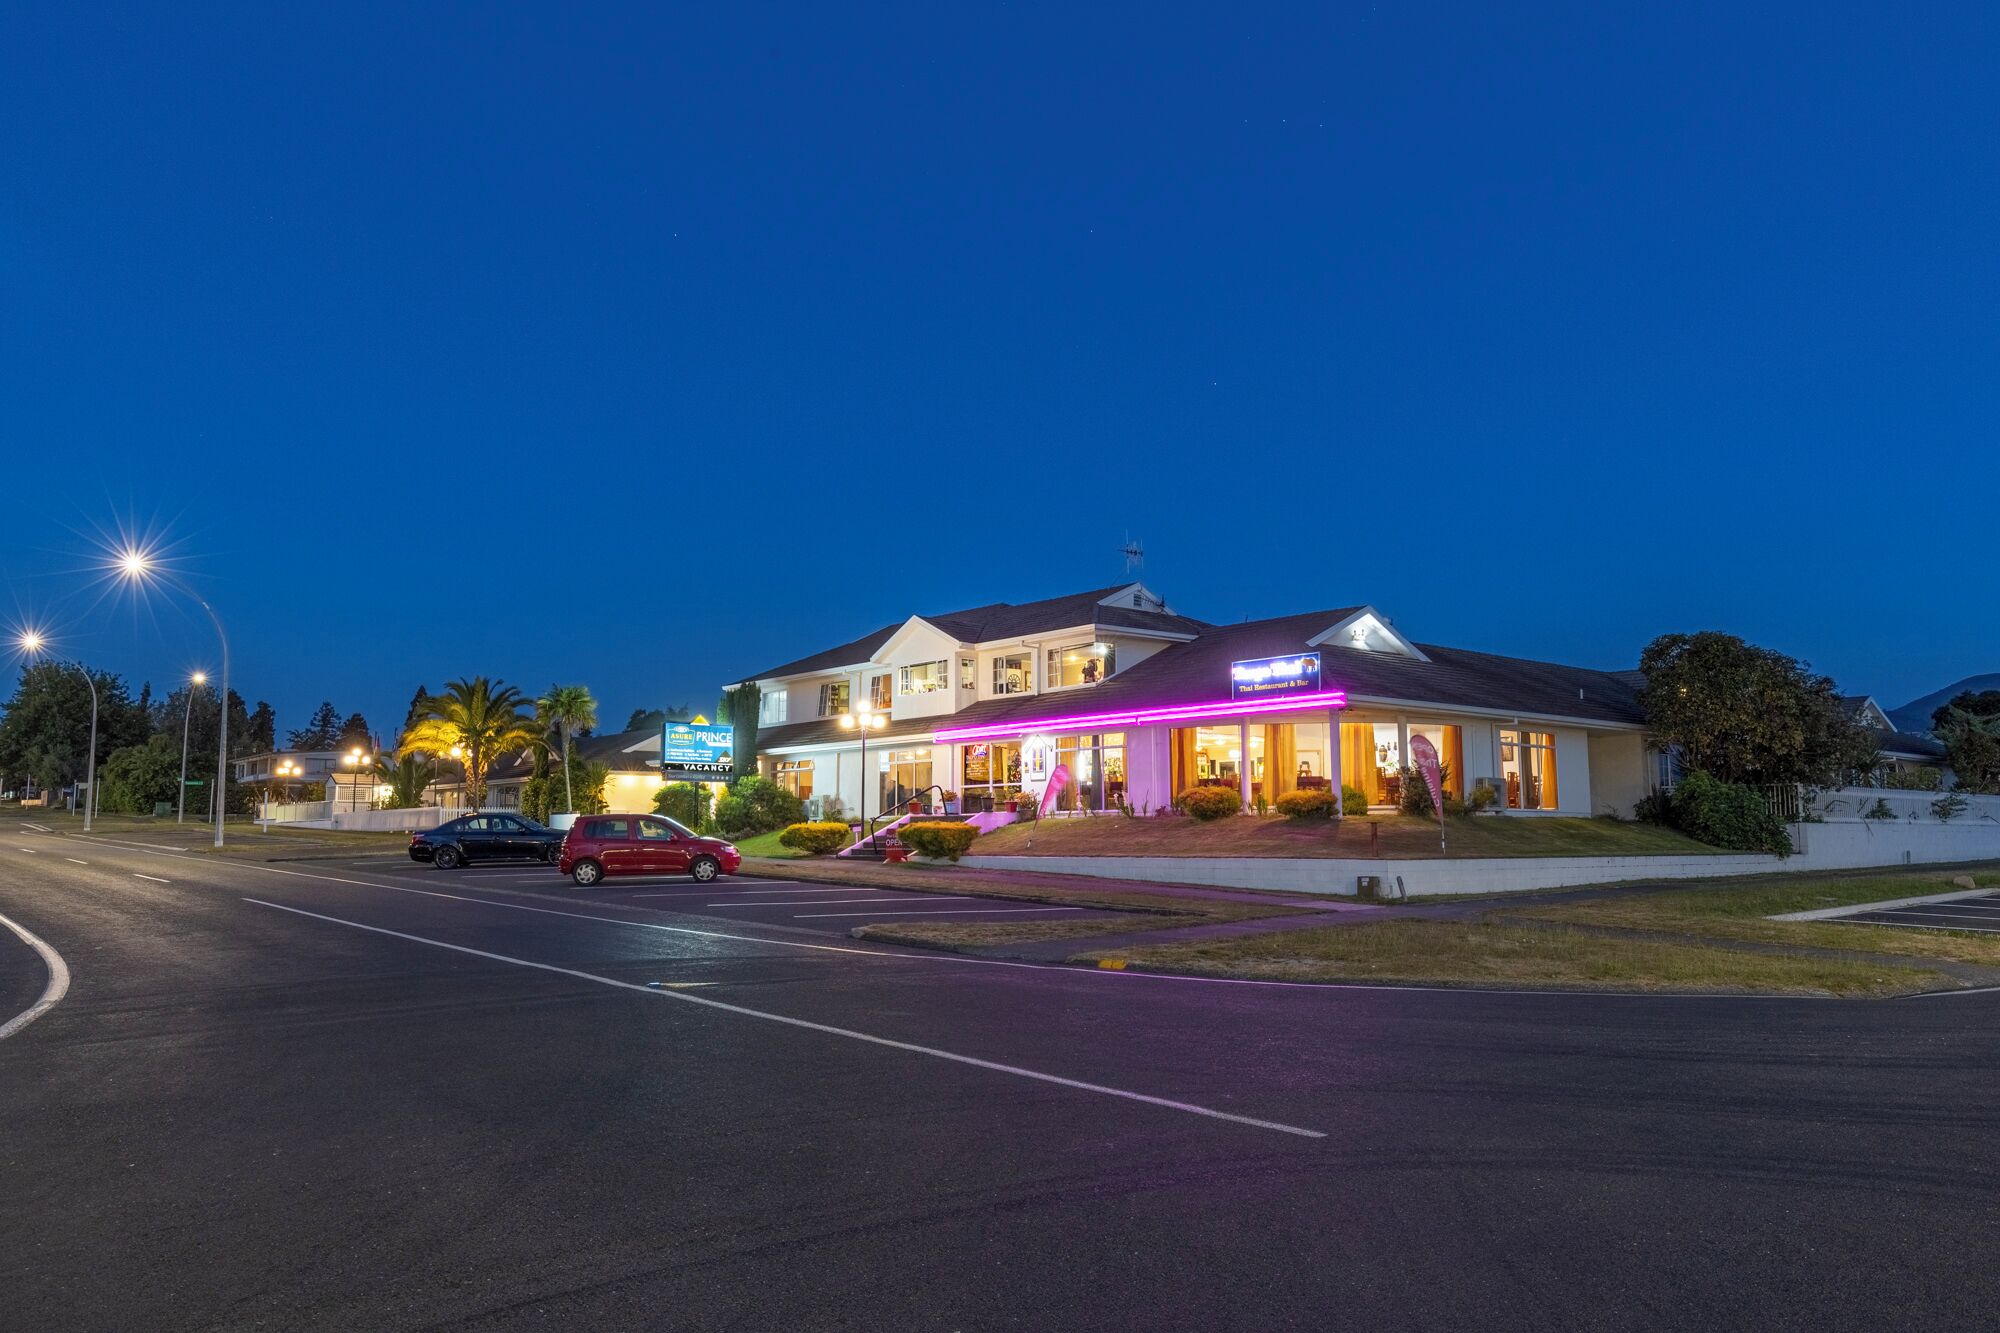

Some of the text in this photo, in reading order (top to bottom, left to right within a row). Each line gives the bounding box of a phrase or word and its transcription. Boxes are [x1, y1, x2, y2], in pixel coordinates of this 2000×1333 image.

[1254, 682, 1288, 691] Restaurant
[696, 731, 732, 743] PRINCE
[684, 763, 730, 772] VACANCY
[885, 838, 902, 847] OPEN
